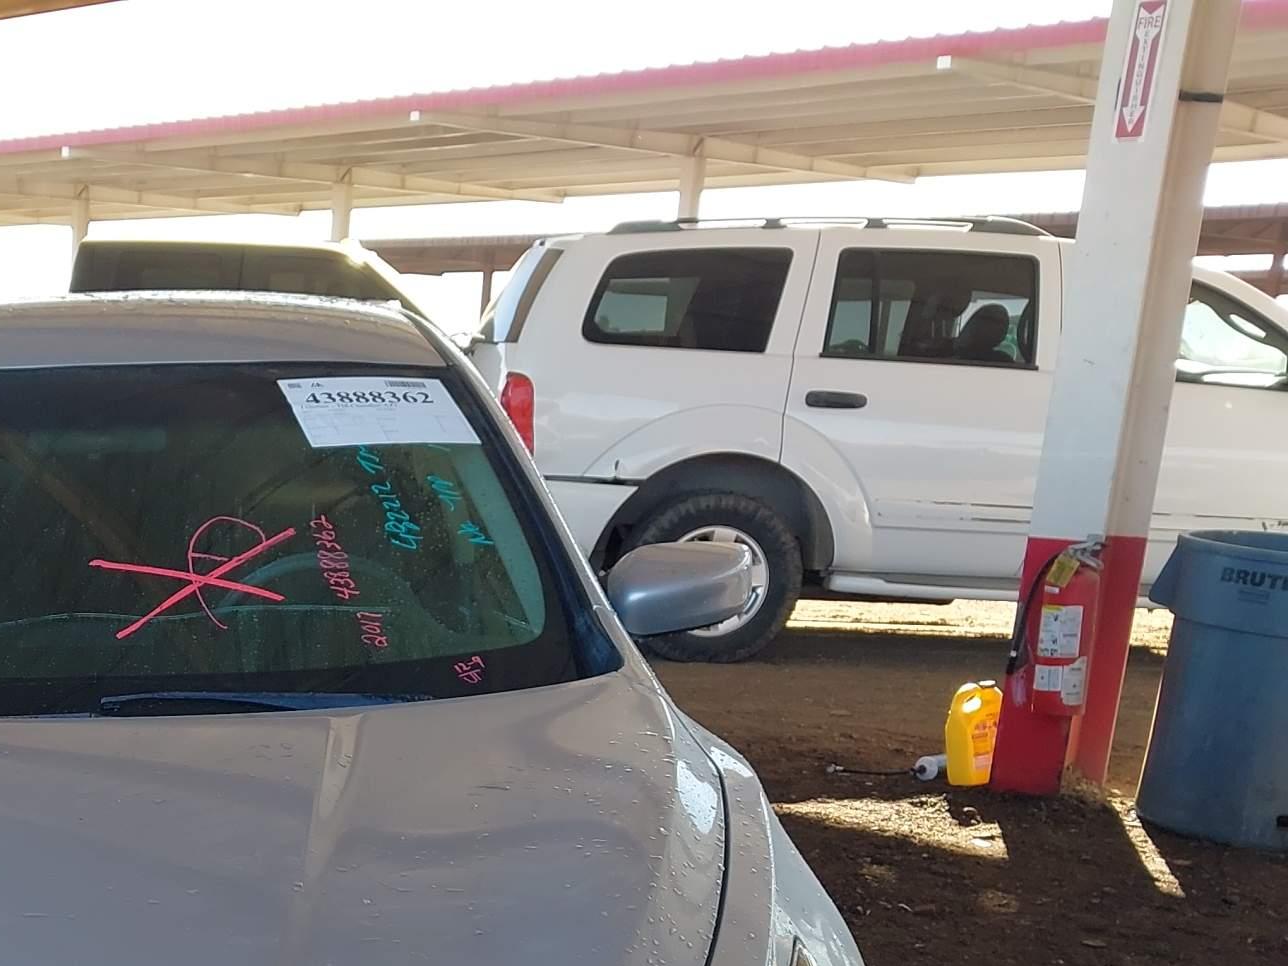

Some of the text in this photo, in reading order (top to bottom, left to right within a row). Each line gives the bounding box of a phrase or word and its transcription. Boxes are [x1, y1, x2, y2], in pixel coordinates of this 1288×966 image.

[1137, 15, 1161, 29] FIRE
[305, 390, 434, 404] 43888362
[310, 514, 360, 600] 43888362
[356, 611, 388, 648] 2017
